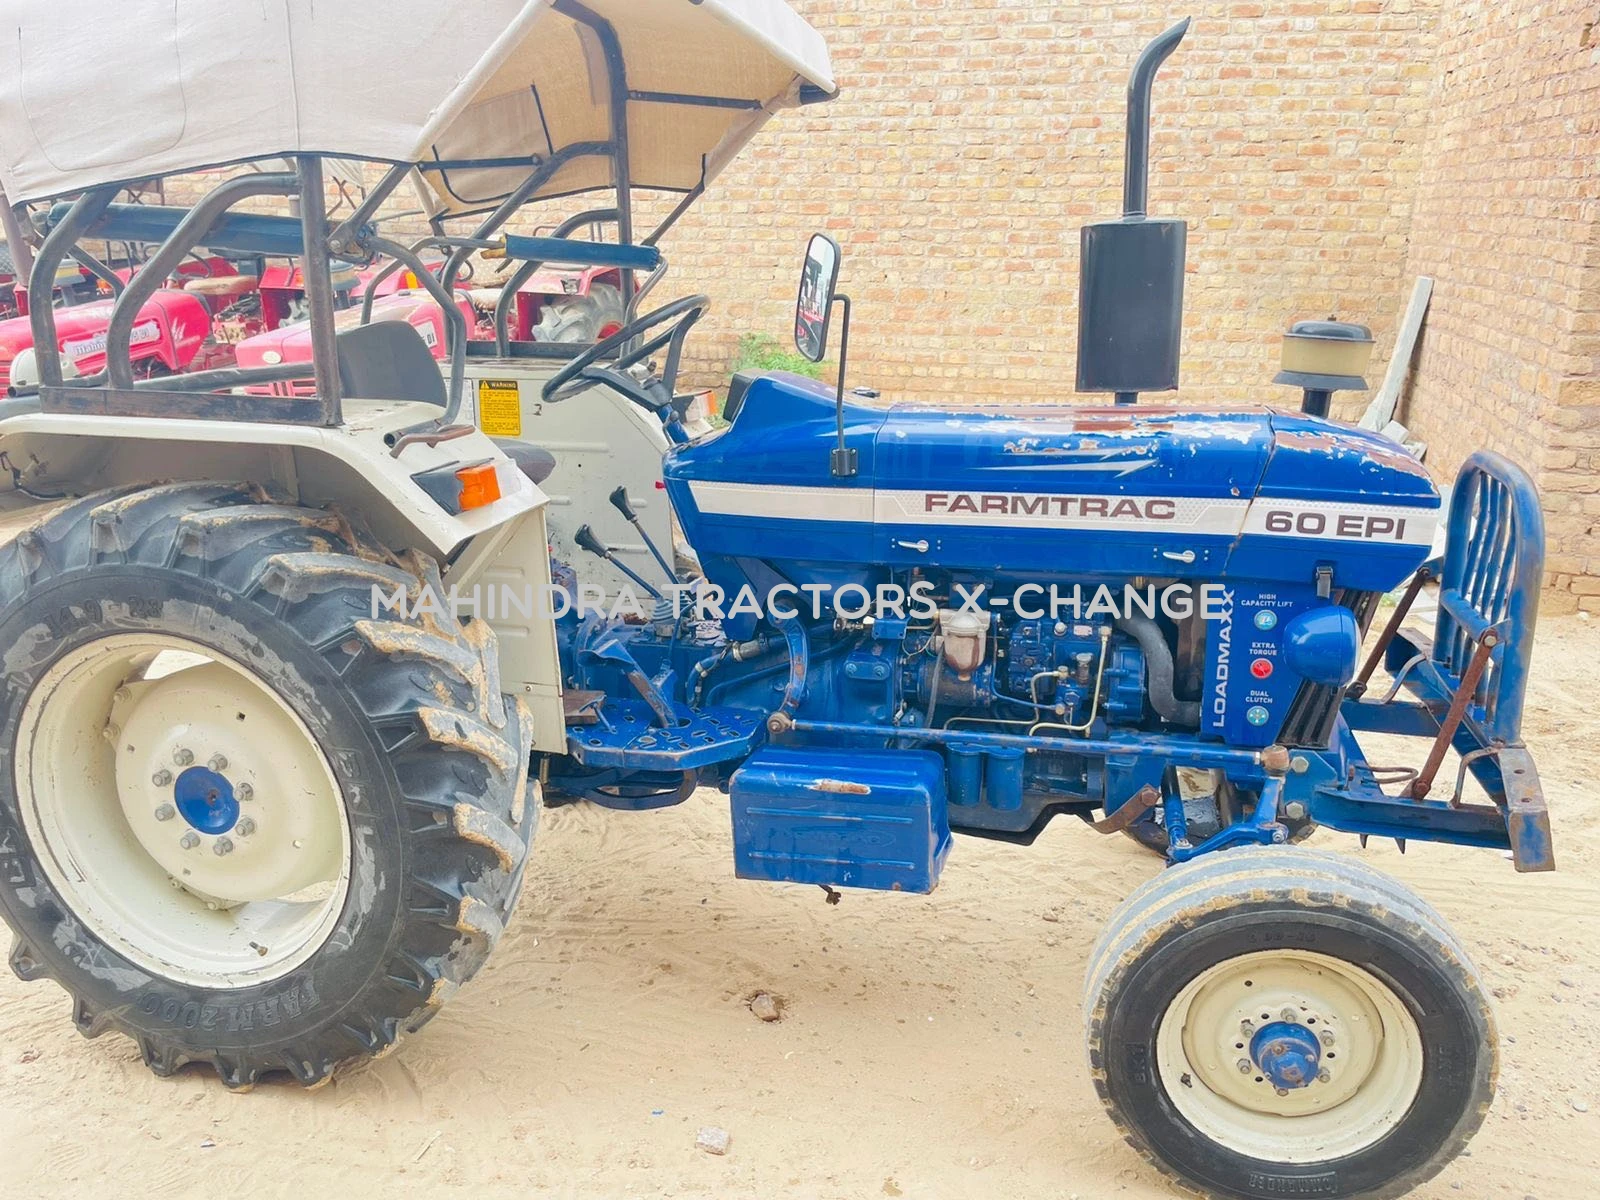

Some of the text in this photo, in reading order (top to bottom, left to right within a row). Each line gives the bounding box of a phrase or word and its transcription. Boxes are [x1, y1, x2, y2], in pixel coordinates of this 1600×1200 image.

[491, 381, 516, 389] WARNING
[924, 493, 1176, 520] FARMTRAC
[1265, 511, 1406, 540] 60 EPI
[1213, 589, 1235, 728] LOADMAXX
[1249, 648, 1277, 656] TORQUE
